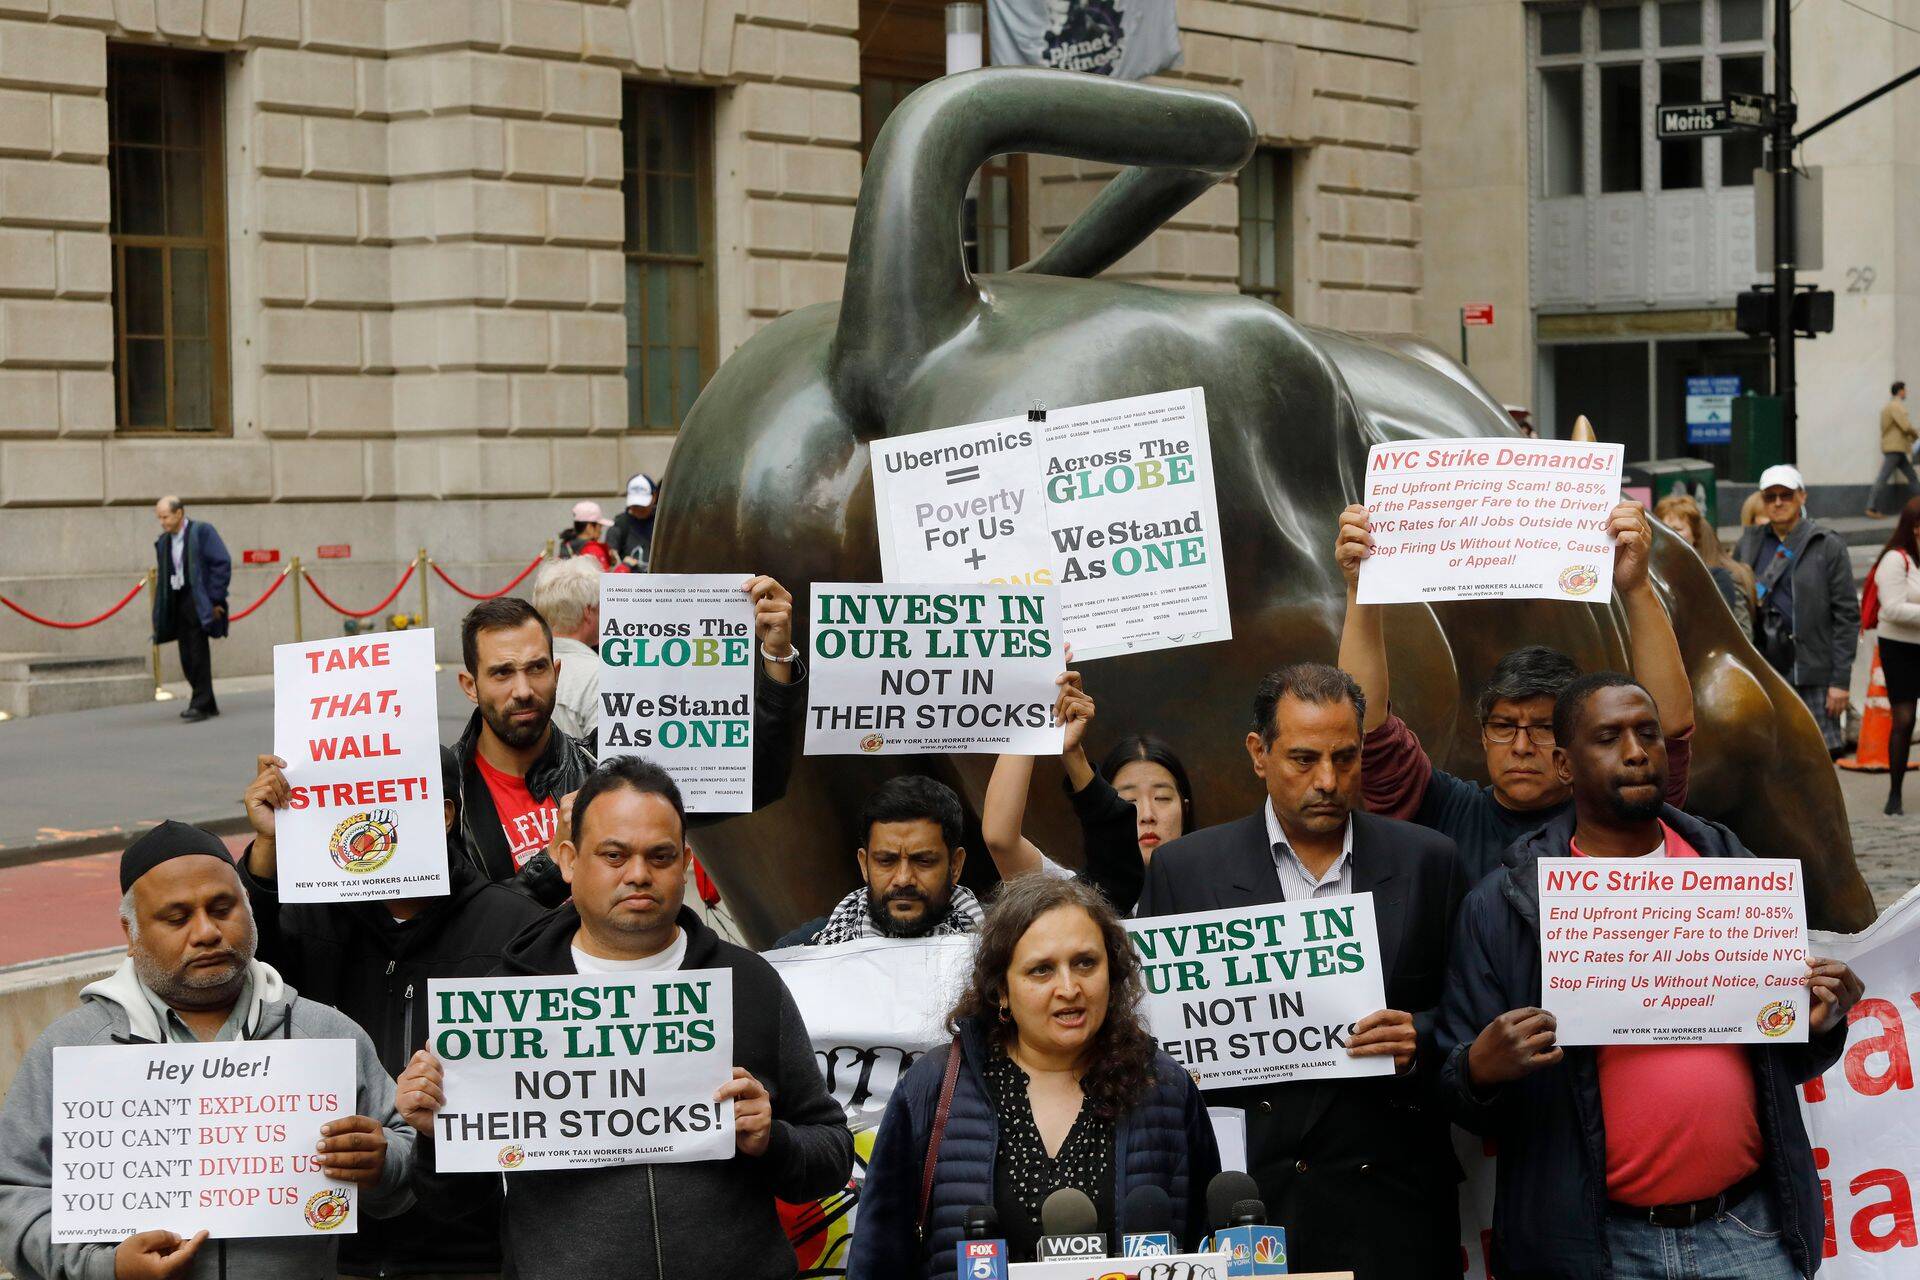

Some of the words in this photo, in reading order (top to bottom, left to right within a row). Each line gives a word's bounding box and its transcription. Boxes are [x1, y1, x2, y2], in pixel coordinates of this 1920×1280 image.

[1665, 113, 1714, 131] Morris
[1846, 266, 1877, 292] 29
[885, 431, 1032, 473] Ubernomics
[1046, 449, 1133, 477] Across
[1139, 439, 1189, 459] The
[1373, 451, 1420, 471] NYC
[1426, 449, 1489, 467] Strike
[1494, 449, 1614, 472] Demands!
[1046, 453, 1195, 503] GLOBE
[1372, 483, 1398, 495] End
[1402, 481, 1451, 495] Upfront
[1454, 480, 1503, 492] Pricing
[1507, 480, 1550, 491] Scam!
[1555, 481, 1605, 495] 80-85%
[916, 489, 1024, 529] Poverty
[1366, 502, 1382, 515] of
[1384, 501, 1404, 512] the
[1407, 499, 1478, 510] Passenger
[1482, 496, 1512, 507] Fare
[1516, 498, 1529, 507] to
[1535, 497, 1556, 508] the
[1560, 499, 1608, 512] Driver!
[925, 527, 969, 551] For
[978, 516, 1014, 539] Us
[1369, 520, 1395, 534] NYC
[1399, 520, 1434, 532] Rates
[1438, 518, 1456, 528] for
[1458, 516, 1478, 527] All
[1481, 516, 1514, 526] Jobs
[1519, 516, 1572, 528] Outside
[1061, 557, 1106, 583] As
[1110, 535, 1206, 576] ONE
[1369, 544, 1396, 559] Stop
[1401, 542, 1436, 554] Firing
[1440, 540, 1456, 551] Us
[1461, 538, 1511, 549] Without
[1515, 538, 1561, 551] Notice,
[1567, 540, 1610, 553] Cause
[1449, 558, 1463, 567] or
[1464, 554, 1516, 568] Appeal!
[818, 594, 985, 624] INVEST
[998, 596, 1044, 624] IN
[603, 619, 690, 637] Across
[700, 619, 747, 636] The
[602, 638, 749, 667] GLOBE
[816, 629, 912, 659] OUR
[925, 629, 1051, 658] LIVES
[306, 643, 390, 673] TAKE
[881, 669, 952, 695] NOT
[962, 669, 993, 694] IN
[310, 690, 401, 720] THAT,
[811, 706, 905, 729] THEIR
[916, 703, 1054, 728] STOCKS!
[309, 733, 401, 761] WALL
[605, 722, 652, 747] As
[658, 720, 749, 748] ONE
[288, 777, 428, 809] STREET!
[362, 877, 401, 885] WORKERS
[403, 874, 440, 882] ALLIANCE
[1547, 871, 1598, 891] NYC
[1607, 871, 1673, 892] Strike
[1682, 871, 1793, 891] Demands!
[340, 889, 400, 897] www.nytwa.org
[1550, 907, 1578, 919] End
[1583, 907, 1637, 922] Upfront
[1642, 906, 1691, 922] Pricing
[1697, 907, 1740, 919] Scam!
[1745, 907, 1793, 919] 80-85%
[1128, 915, 1285, 960] NVEST
[1300, 906, 1354, 942] IN
[1547, 928, 1562, 940] of
[1566, 928, 1588, 940] the
[1593, 928, 1669, 942] Passenger
[1674, 927, 1704, 939] Fare
[1709, 928, 1722, 939] to
[1727, 927, 1748, 938] the
[1754, 926, 1798, 938] Driver!
[1143, 961, 1210, 994] UR
[1222, 939, 1364, 986] LIVES
[1548, 951, 1579, 963] NYC
[1584, 951, 1624, 962] Rates
[1629, 950, 1649, 962] for
[1652, 950, 1671, 962] All
[1676, 950, 1709, 962] Jobs
[1715, 949, 1768, 961] Outside
[1773, 949, 1806, 961] NYC!
[1550, 977, 1581, 991] Stop
[1586, 976, 1626, 991] Firing
[1631, 976, 1649, 988] Us
[1655, 976, 1708, 987] Without
[1712, 975, 1760, 989] Notice,
[1765, 974, 1808, 989] Cause
[436, 986, 635, 1024] INVEST
[653, 982, 711, 1016] IN
[1183, 996, 1257, 1029] NOT
[1269, 991, 1304, 1019] IN
[1643, 998, 1658, 1007] or
[1661, 995, 1714, 1010] Appeal!
[437, 1028, 547, 1060] OUR
[563, 1020, 715, 1058] LIVES
[147, 1060, 194, 1084] Hey
[203, 1056, 270, 1078] Uber!
[515, 1070, 596, 1099] NOT
[610, 1068, 645, 1098] IN
[62, 1101, 114, 1119] YOU
[122, 1099, 191, 1117] CAN'T
[199, 1095, 301, 1115] EXPLOIT
[307, 1094, 337, 1111] US
[435, 1109, 546, 1141] THEIR
[560, 1100, 724, 1138] STOCKS!
[62, 1131, 114, 1148] YOU
[122, 1128, 191, 1147] CAN'T
[198, 1126, 248, 1144] BUY
[254, 1125, 286, 1142] US
[63, 1162, 115, 1180] YOU
[123, 1160, 192, 1178] CAN'T
[200, 1156, 283, 1176] DIVIDE
[291, 1155, 323, 1173] US
[62, 1193, 114, 1211] YOU
[122, 1191, 192, 1210] CAN'T
[200, 1188, 260, 1208] STOP
[267, 1186, 300, 1205] US
[970, 1244, 993, 1255] FOX
[1048, 1237, 1102, 1254] WOR
[973, 1258, 992, 1278] 5
